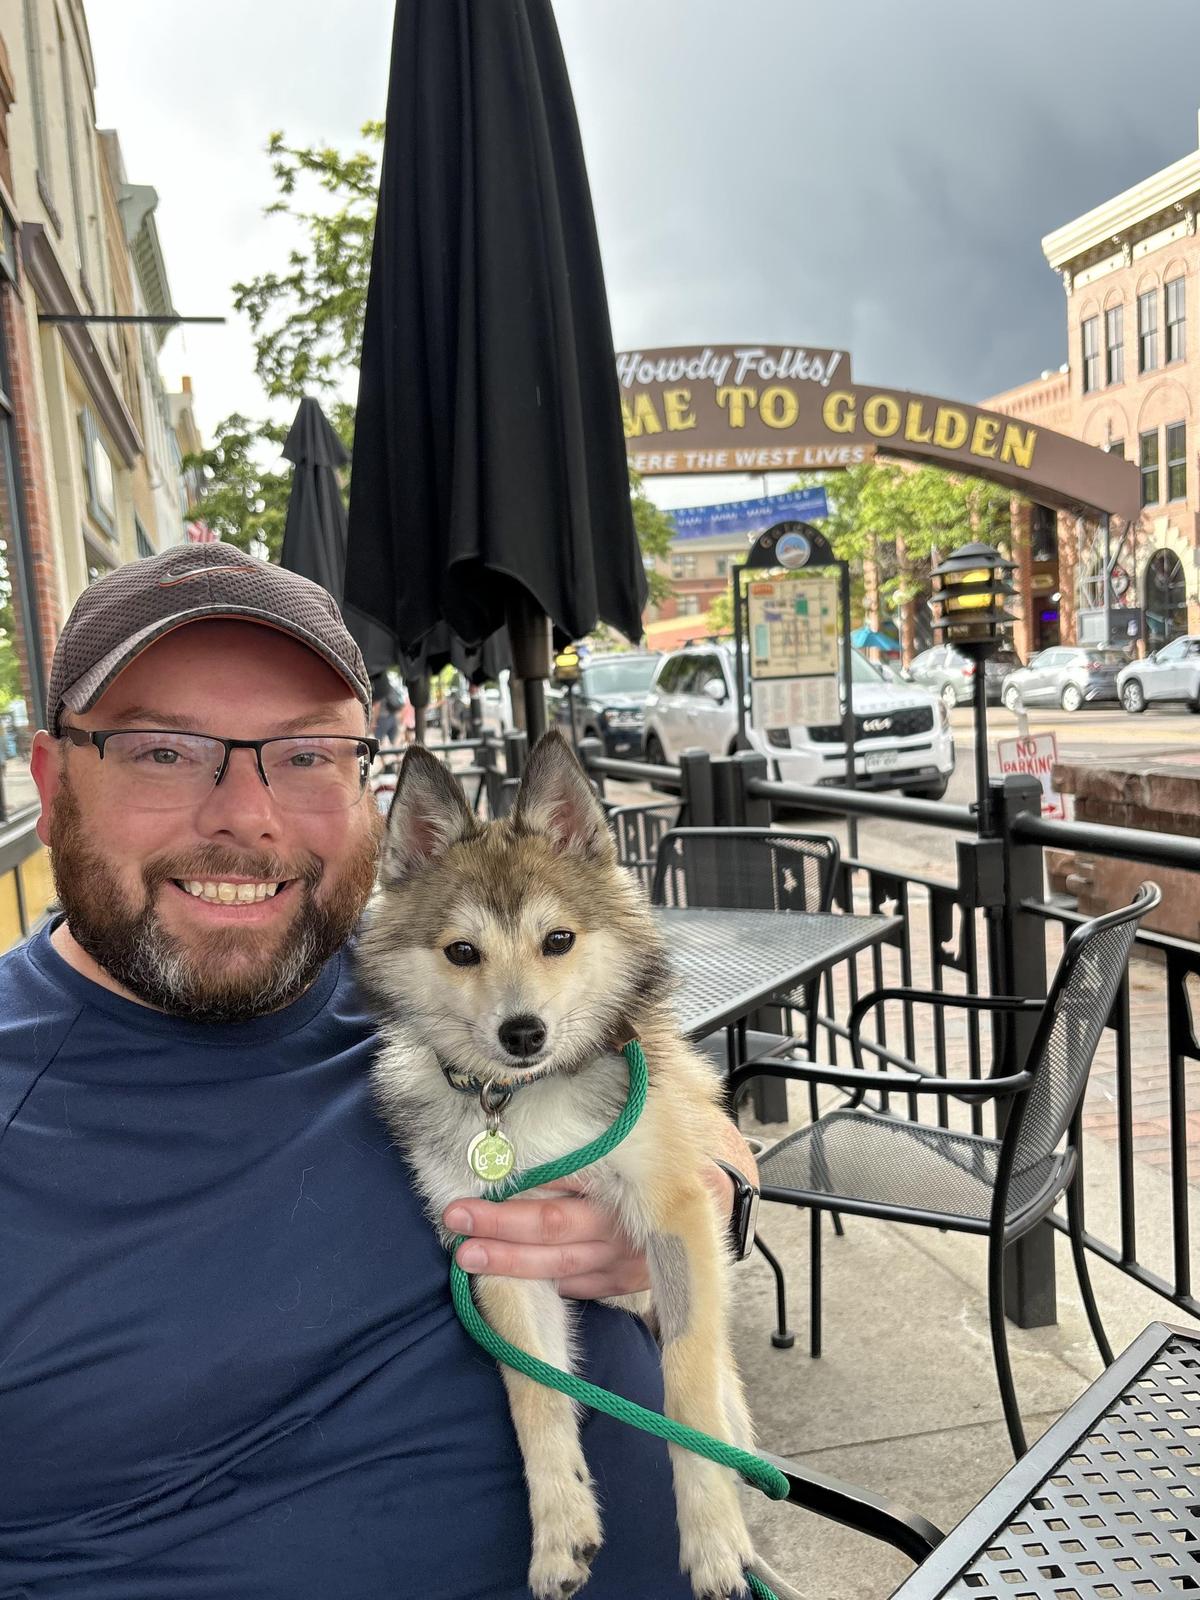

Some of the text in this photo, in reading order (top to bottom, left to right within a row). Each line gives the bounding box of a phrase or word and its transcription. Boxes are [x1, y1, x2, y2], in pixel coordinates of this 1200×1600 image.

[617, 348, 842, 389] Howdy Folks!
[715, 386, 799, 429] TO
[822, 390, 1038, 470] GOLDEN
[683, 451, 729, 470] THE
[735, 449, 798, 468] WEST
[803, 445, 865, 465] LIVES
[1016, 738, 1037, 758] NO
